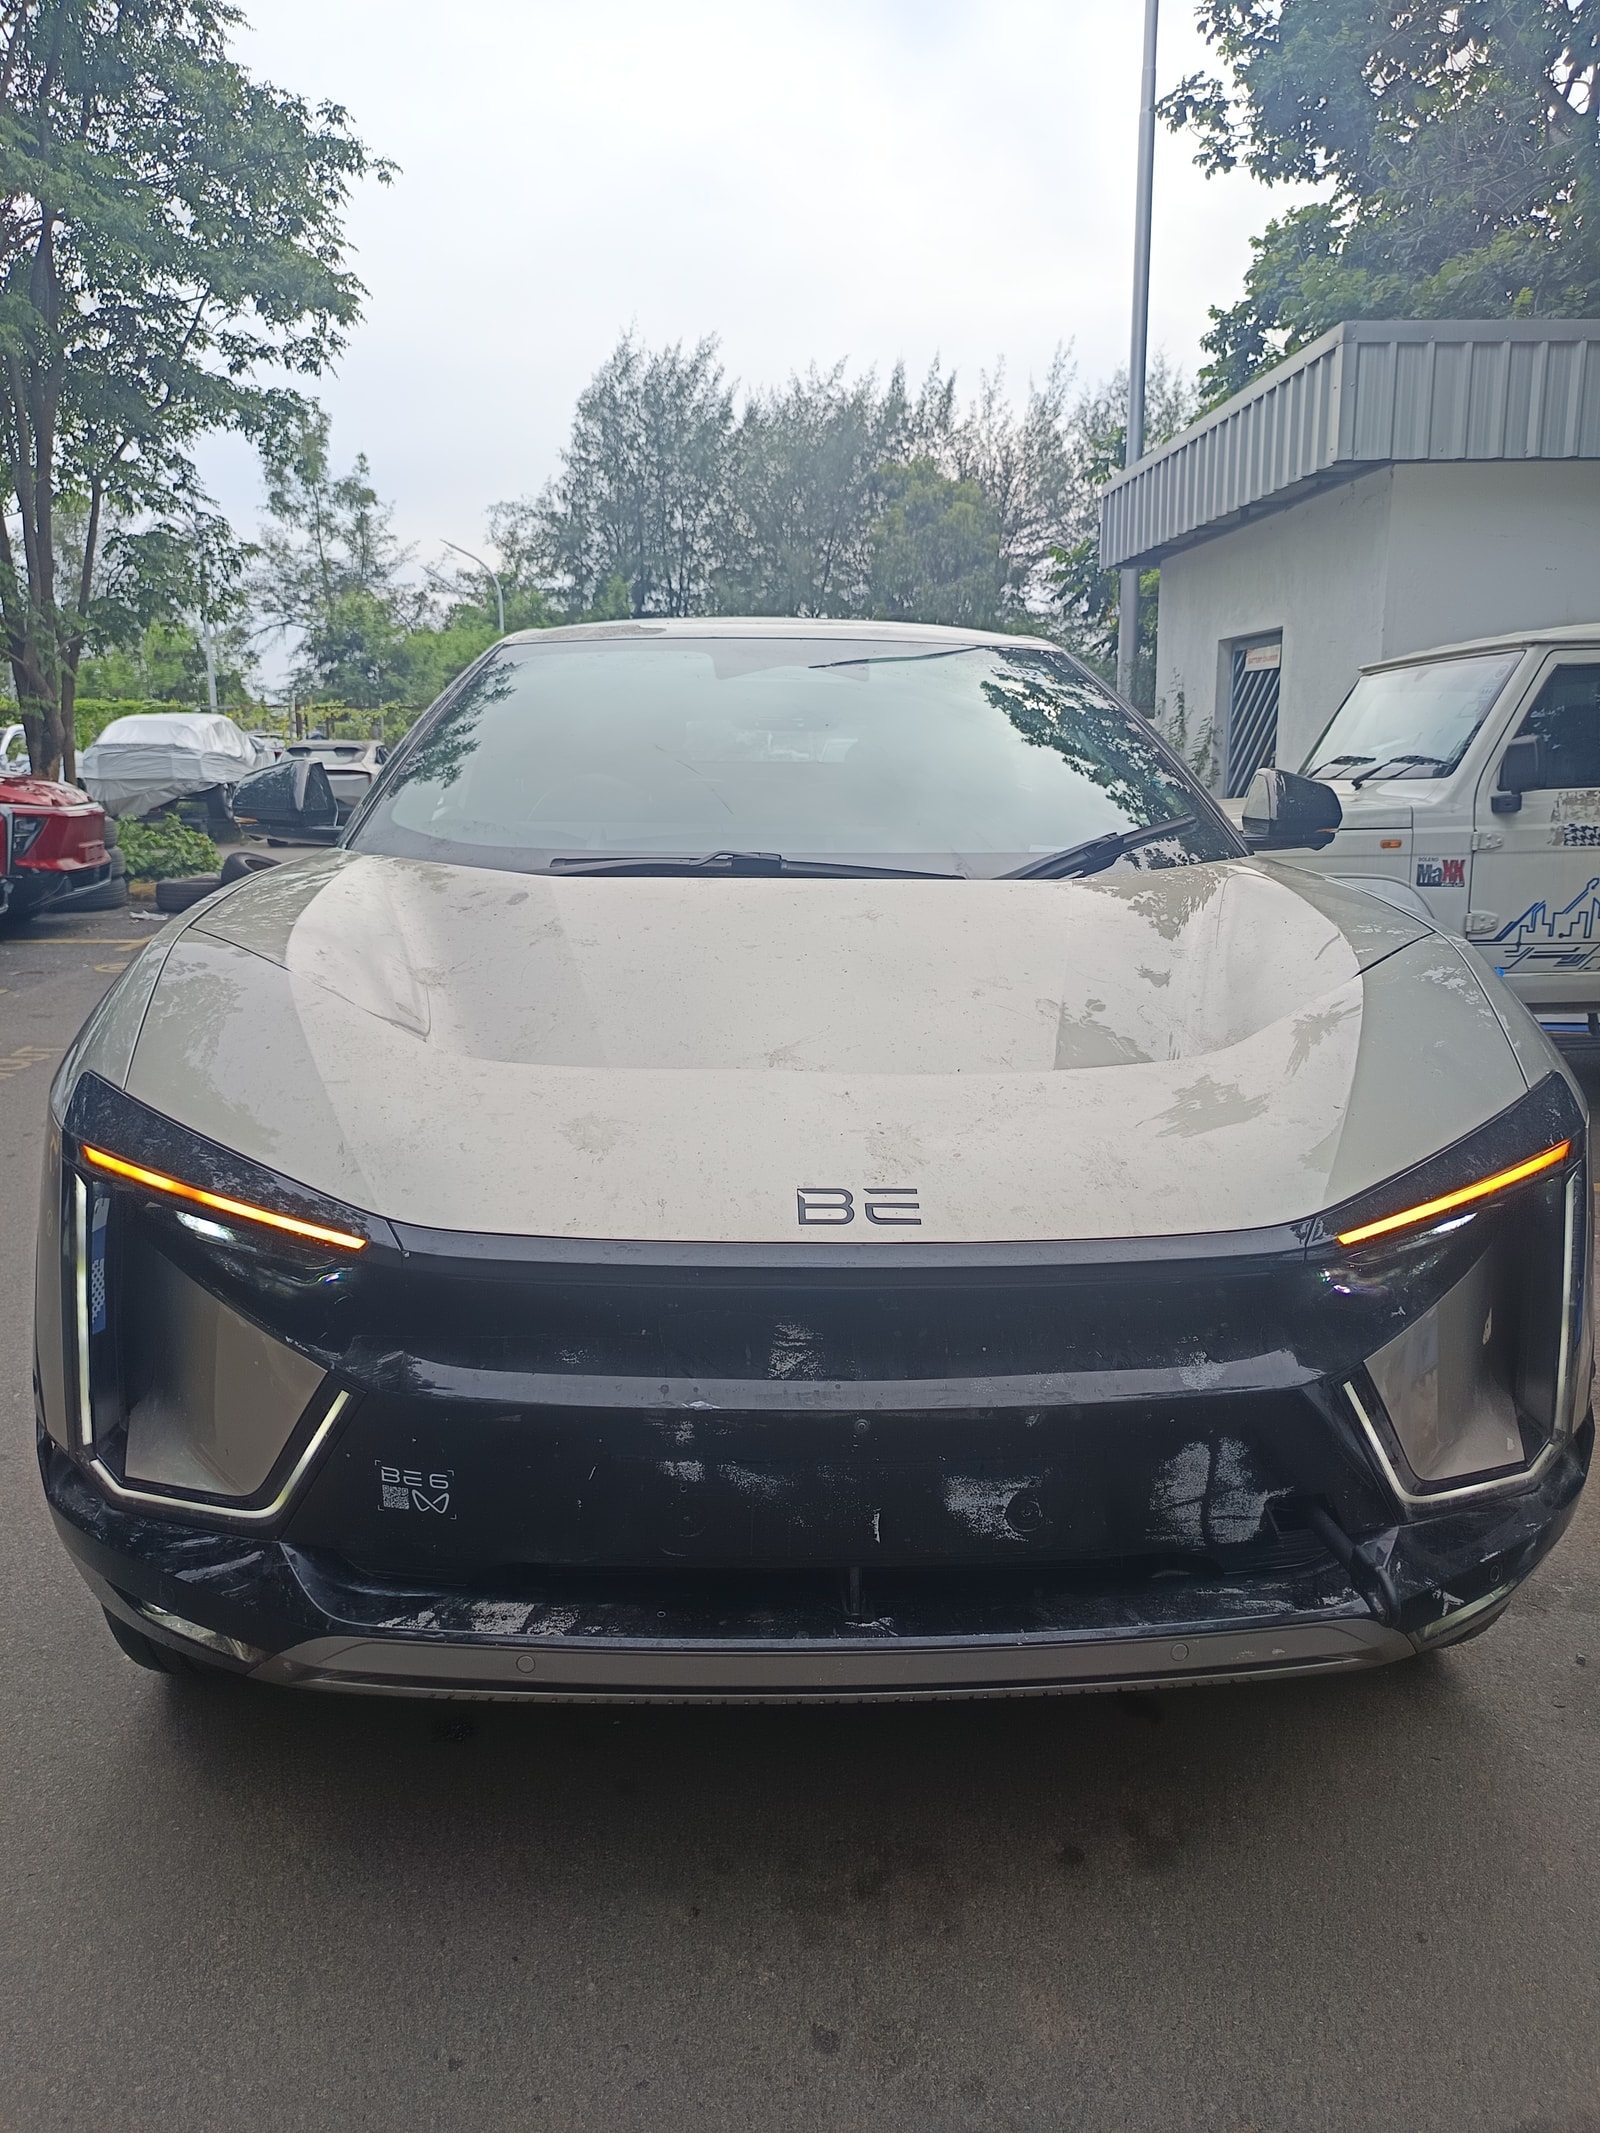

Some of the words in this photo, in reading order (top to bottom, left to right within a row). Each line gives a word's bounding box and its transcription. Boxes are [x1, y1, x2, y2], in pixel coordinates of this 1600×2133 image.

[797, 1188, 922, 1225] BE
[381, 1466, 423, 1487] BE
[429, 1473, 449, 1489] 6
